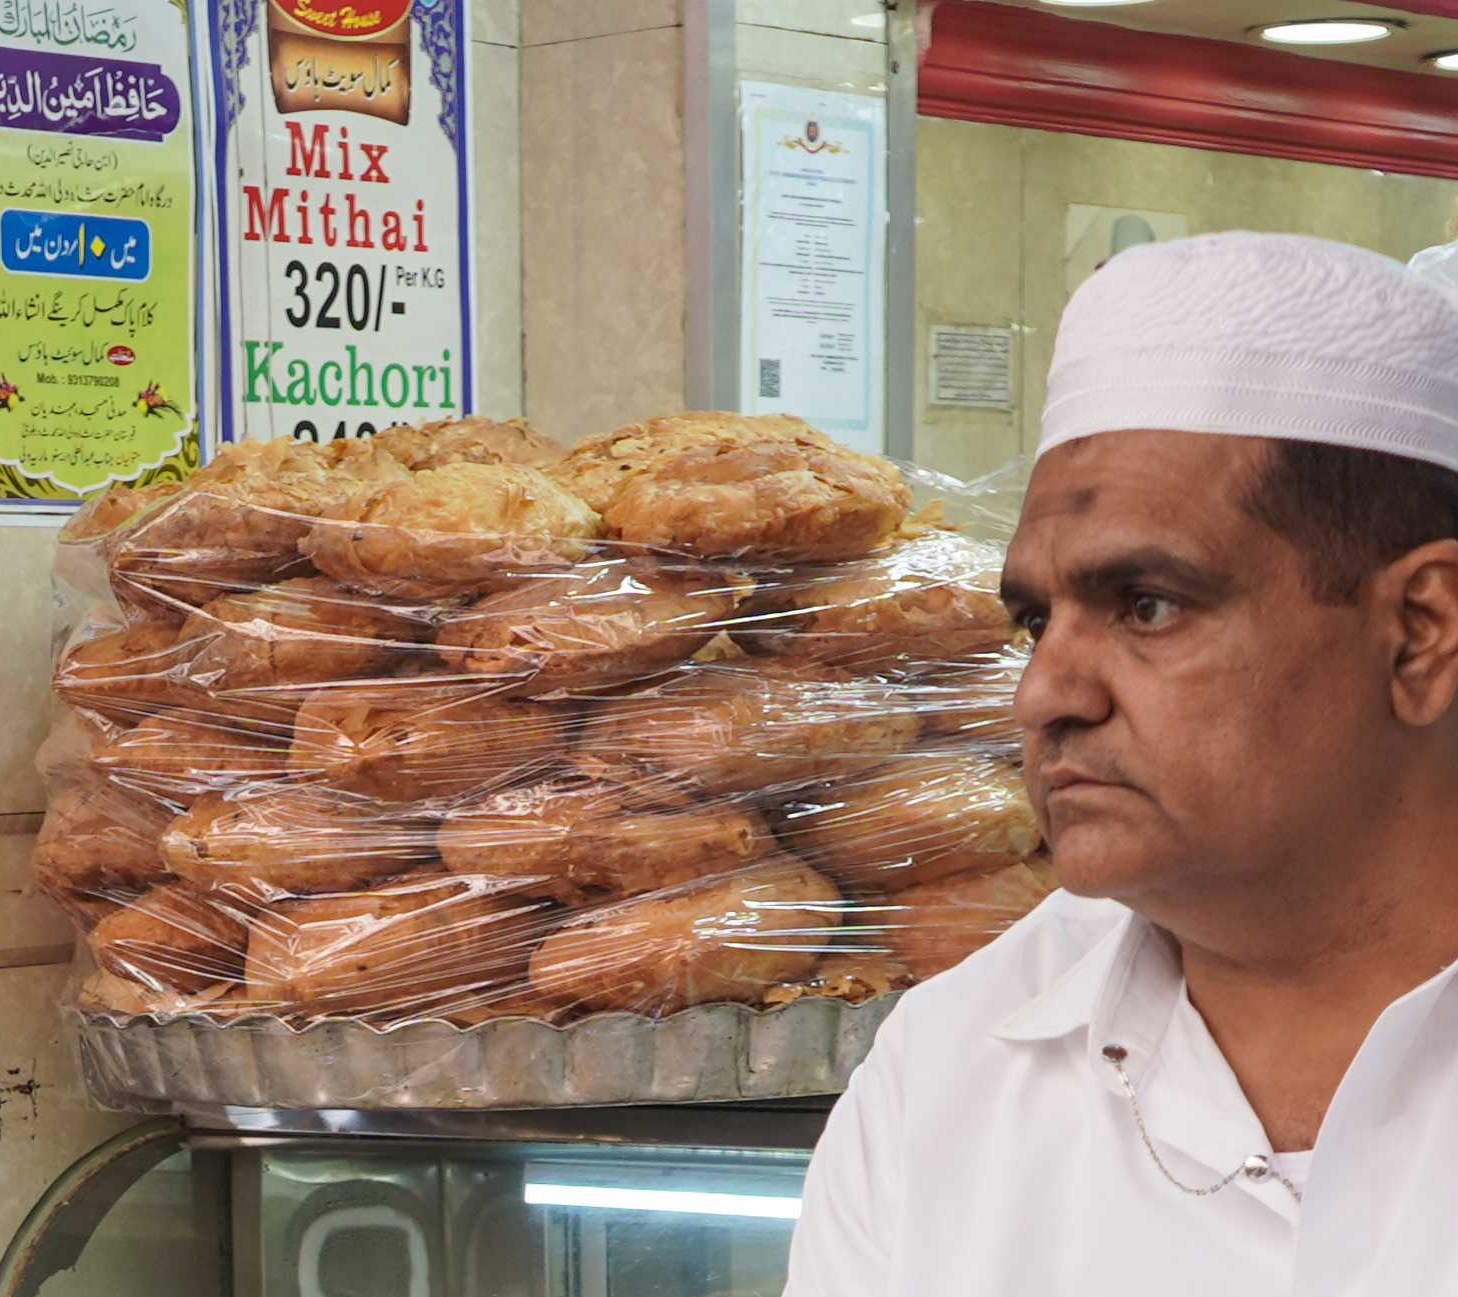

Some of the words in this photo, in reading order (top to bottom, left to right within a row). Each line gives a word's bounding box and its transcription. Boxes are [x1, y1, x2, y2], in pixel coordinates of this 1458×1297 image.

[285, 121, 390, 184] Mix
[243, 186, 429, 252] Mithai
[284, 260, 405, 331] 320/-
[396, 265, 418, 288] Per
[421, 267, 445, 289] K.G
[241, 340, 456, 409] Kachori
